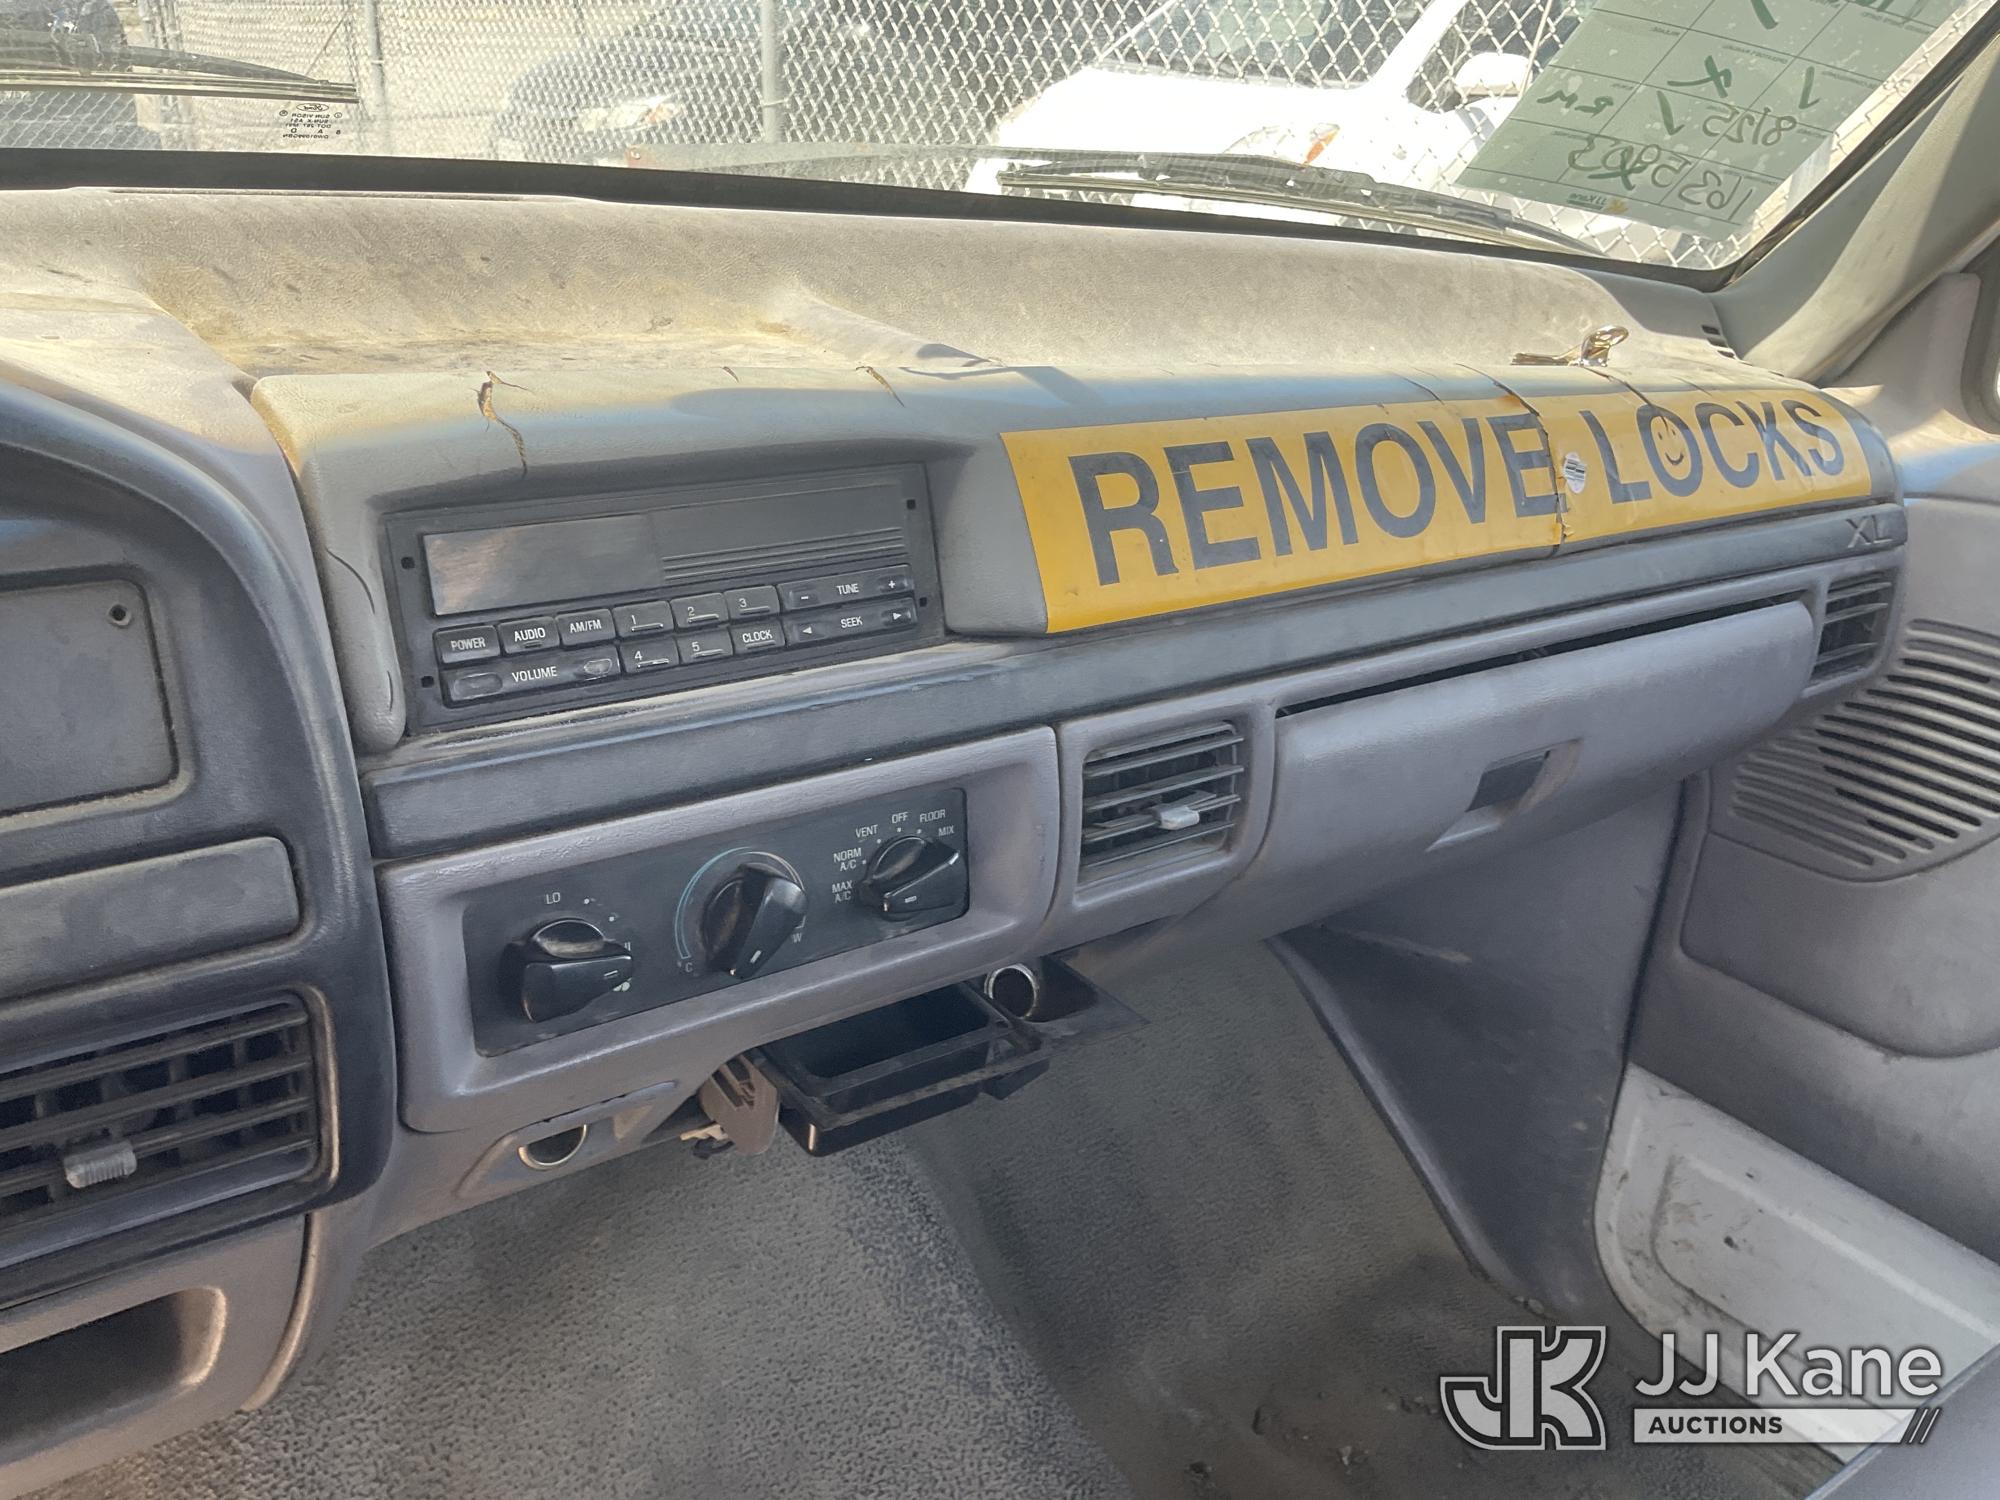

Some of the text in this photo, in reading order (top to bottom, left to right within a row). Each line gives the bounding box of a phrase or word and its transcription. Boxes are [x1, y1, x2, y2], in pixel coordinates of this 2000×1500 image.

[1068, 398, 1847, 586] REMOVE LOCKS
[1845, 514, 1894, 549] XL
[836, 583, 860, 595] TUNE
[738, 598, 748, 608] 3
[687, 606, 696, 617] 2
[569, 619, 602, 634] AM/FM
[840, 616, 863, 629] SEEK
[513, 627, 546, 642] AUDIO
[741, 629, 774, 644] CLOCK
[450, 636, 487, 651] POWER
[691, 641, 701, 652] 5
[634, 650, 643, 661] 4
[511, 665, 558, 683] VOLUME
[891, 811, 909, 824] OFF
[919, 809, 946, 823] FLOOR
[855, 824, 879, 838] VENT
[938, 825, 955, 837] MIX
[833, 847, 862, 863] NORM
[839, 859, 857, 872] A/C
[831, 879, 853, 894] MAX
[545, 891, 561, 905] LO
[834, 890, 852, 904] A/C
